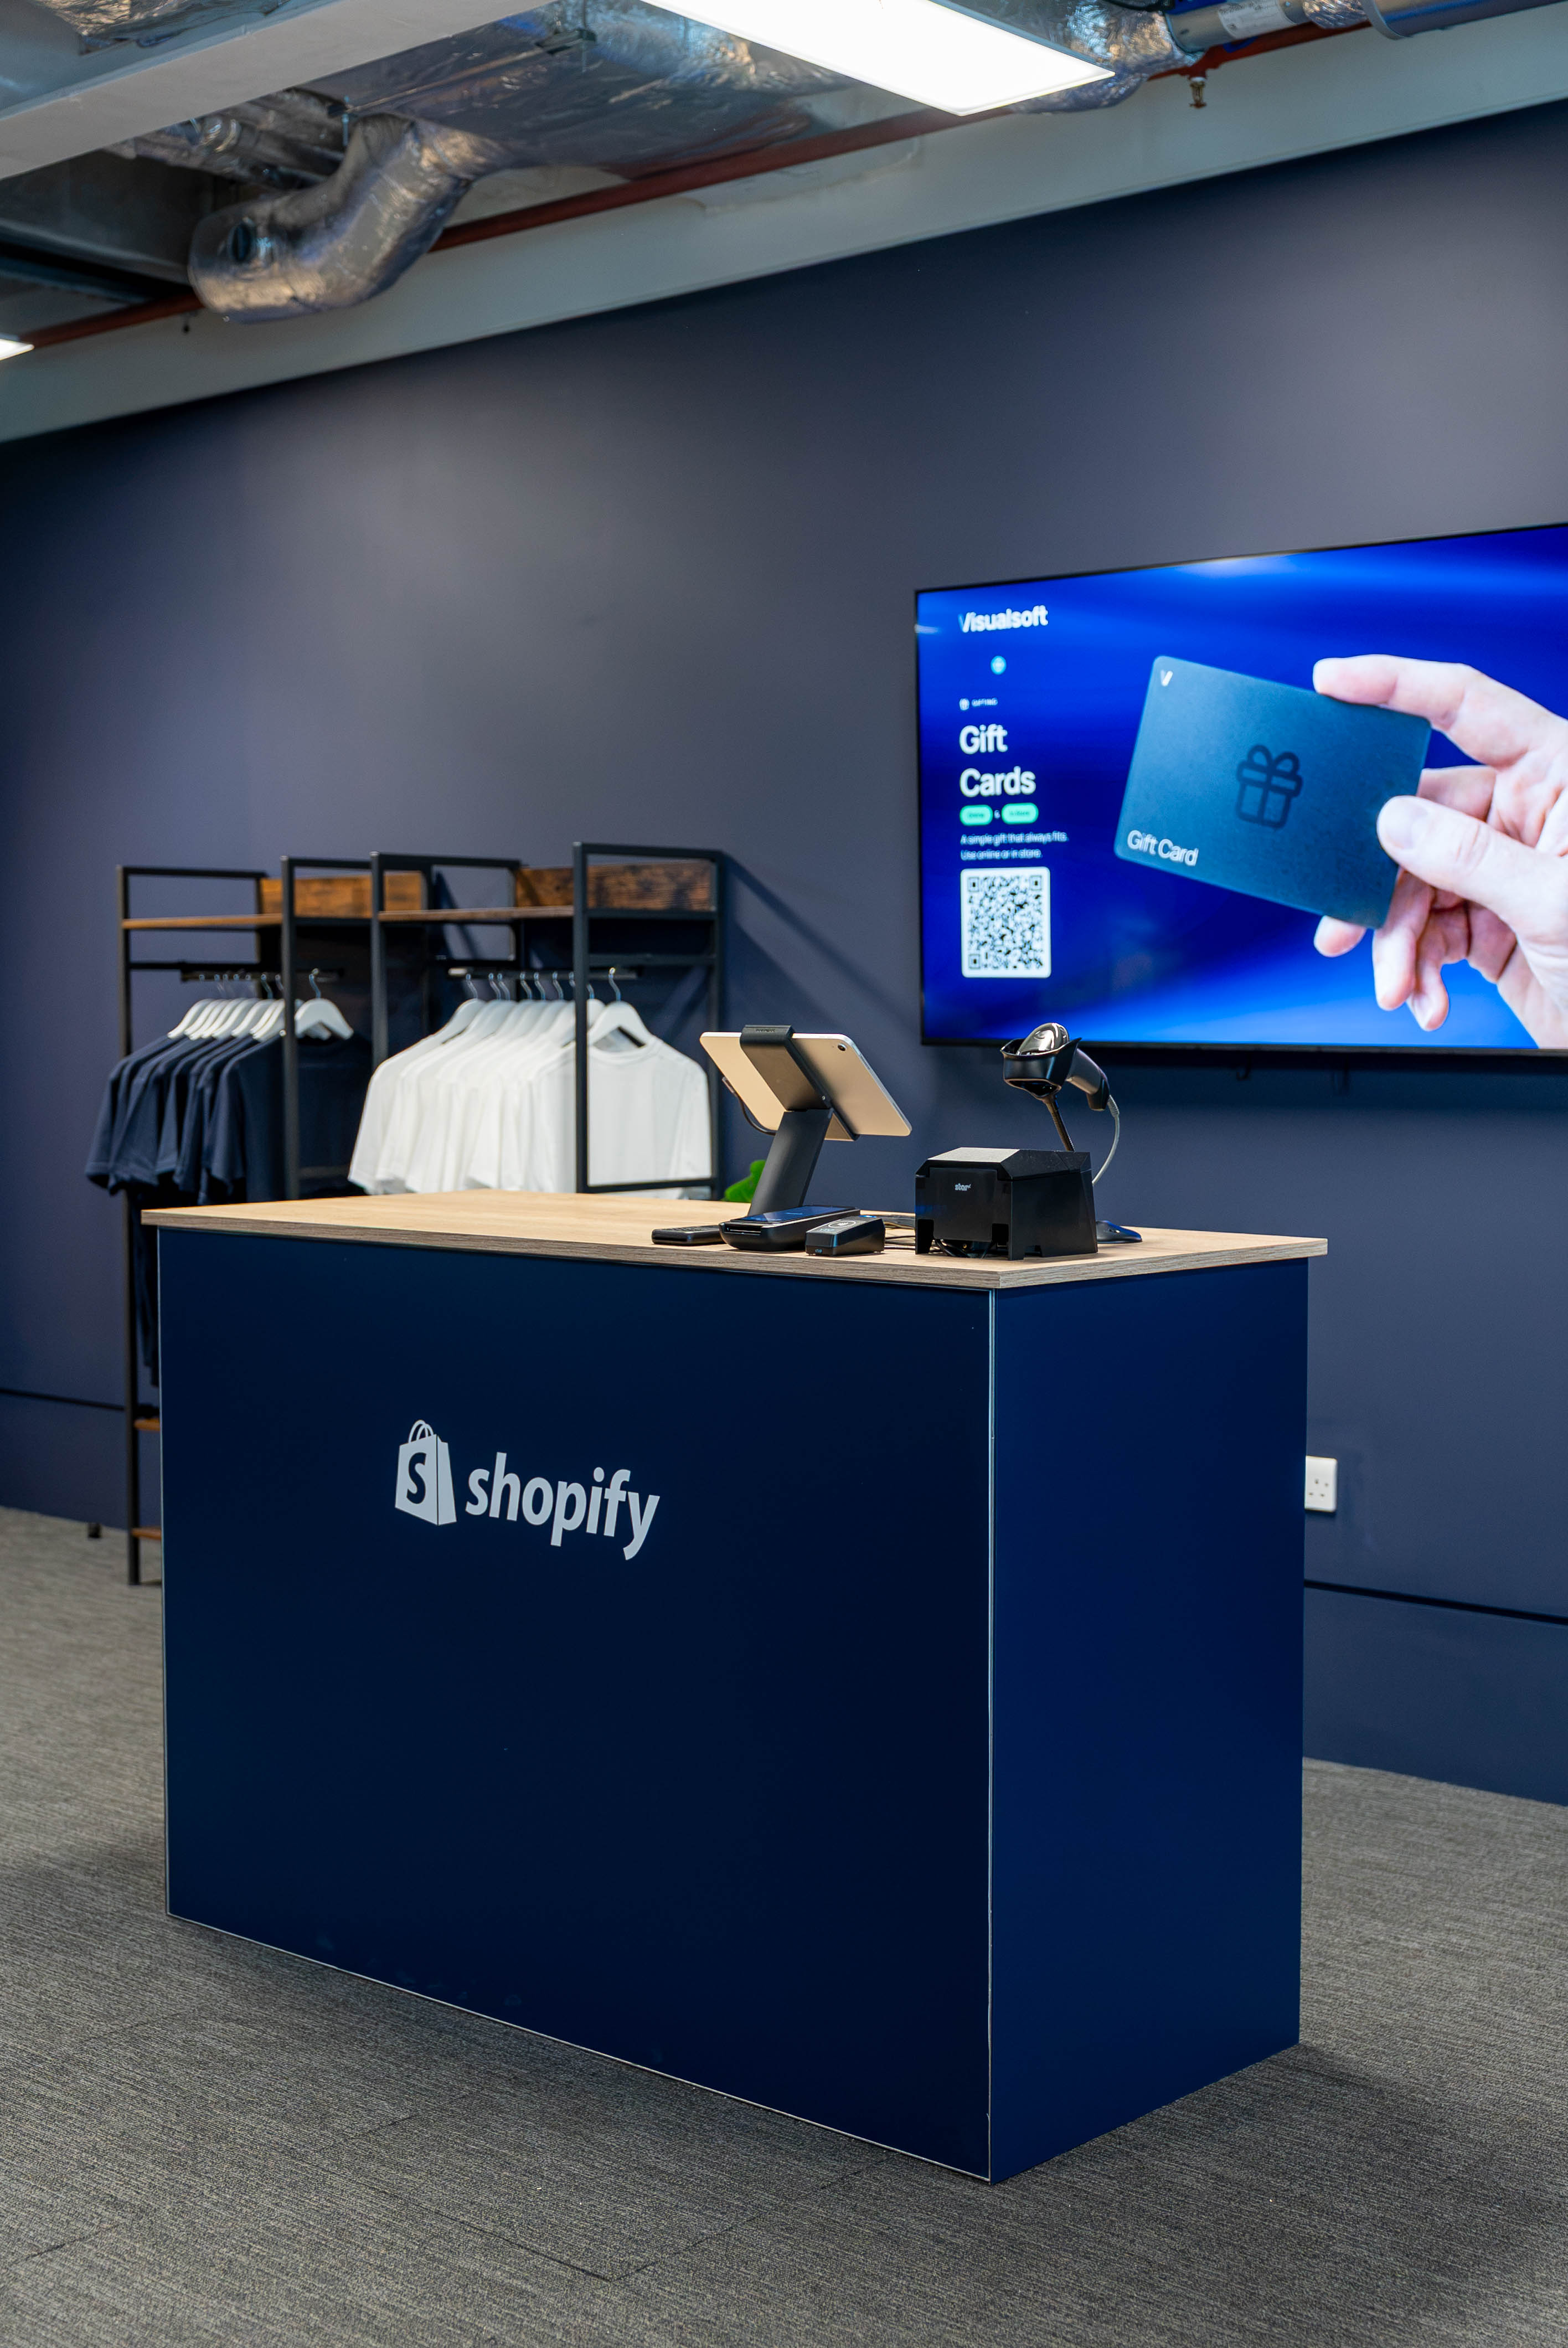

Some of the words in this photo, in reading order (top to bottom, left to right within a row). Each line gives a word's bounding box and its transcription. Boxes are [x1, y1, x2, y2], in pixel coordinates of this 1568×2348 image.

[958, 605, 1048, 632] Visualsoft
[960, 724, 1008, 754] Gift
[960, 766, 1036, 797] Cards
[961, 835, 967, 845] A
[968, 834, 993, 846] simple
[993, 833, 1007, 847] gift
[1008, 833, 1024, 843] that
[1025, 832, 1052, 845] always
[961, 850, 977, 861] Use
[977, 849, 1000, 860] online
[1000, 849, 1010, 860] or
[1010, 848, 1018, 858] in
[1127, 830, 1158, 855] Gift
[1158, 838, 1199, 866] Card
[465, 1451, 660, 1561] shopify
